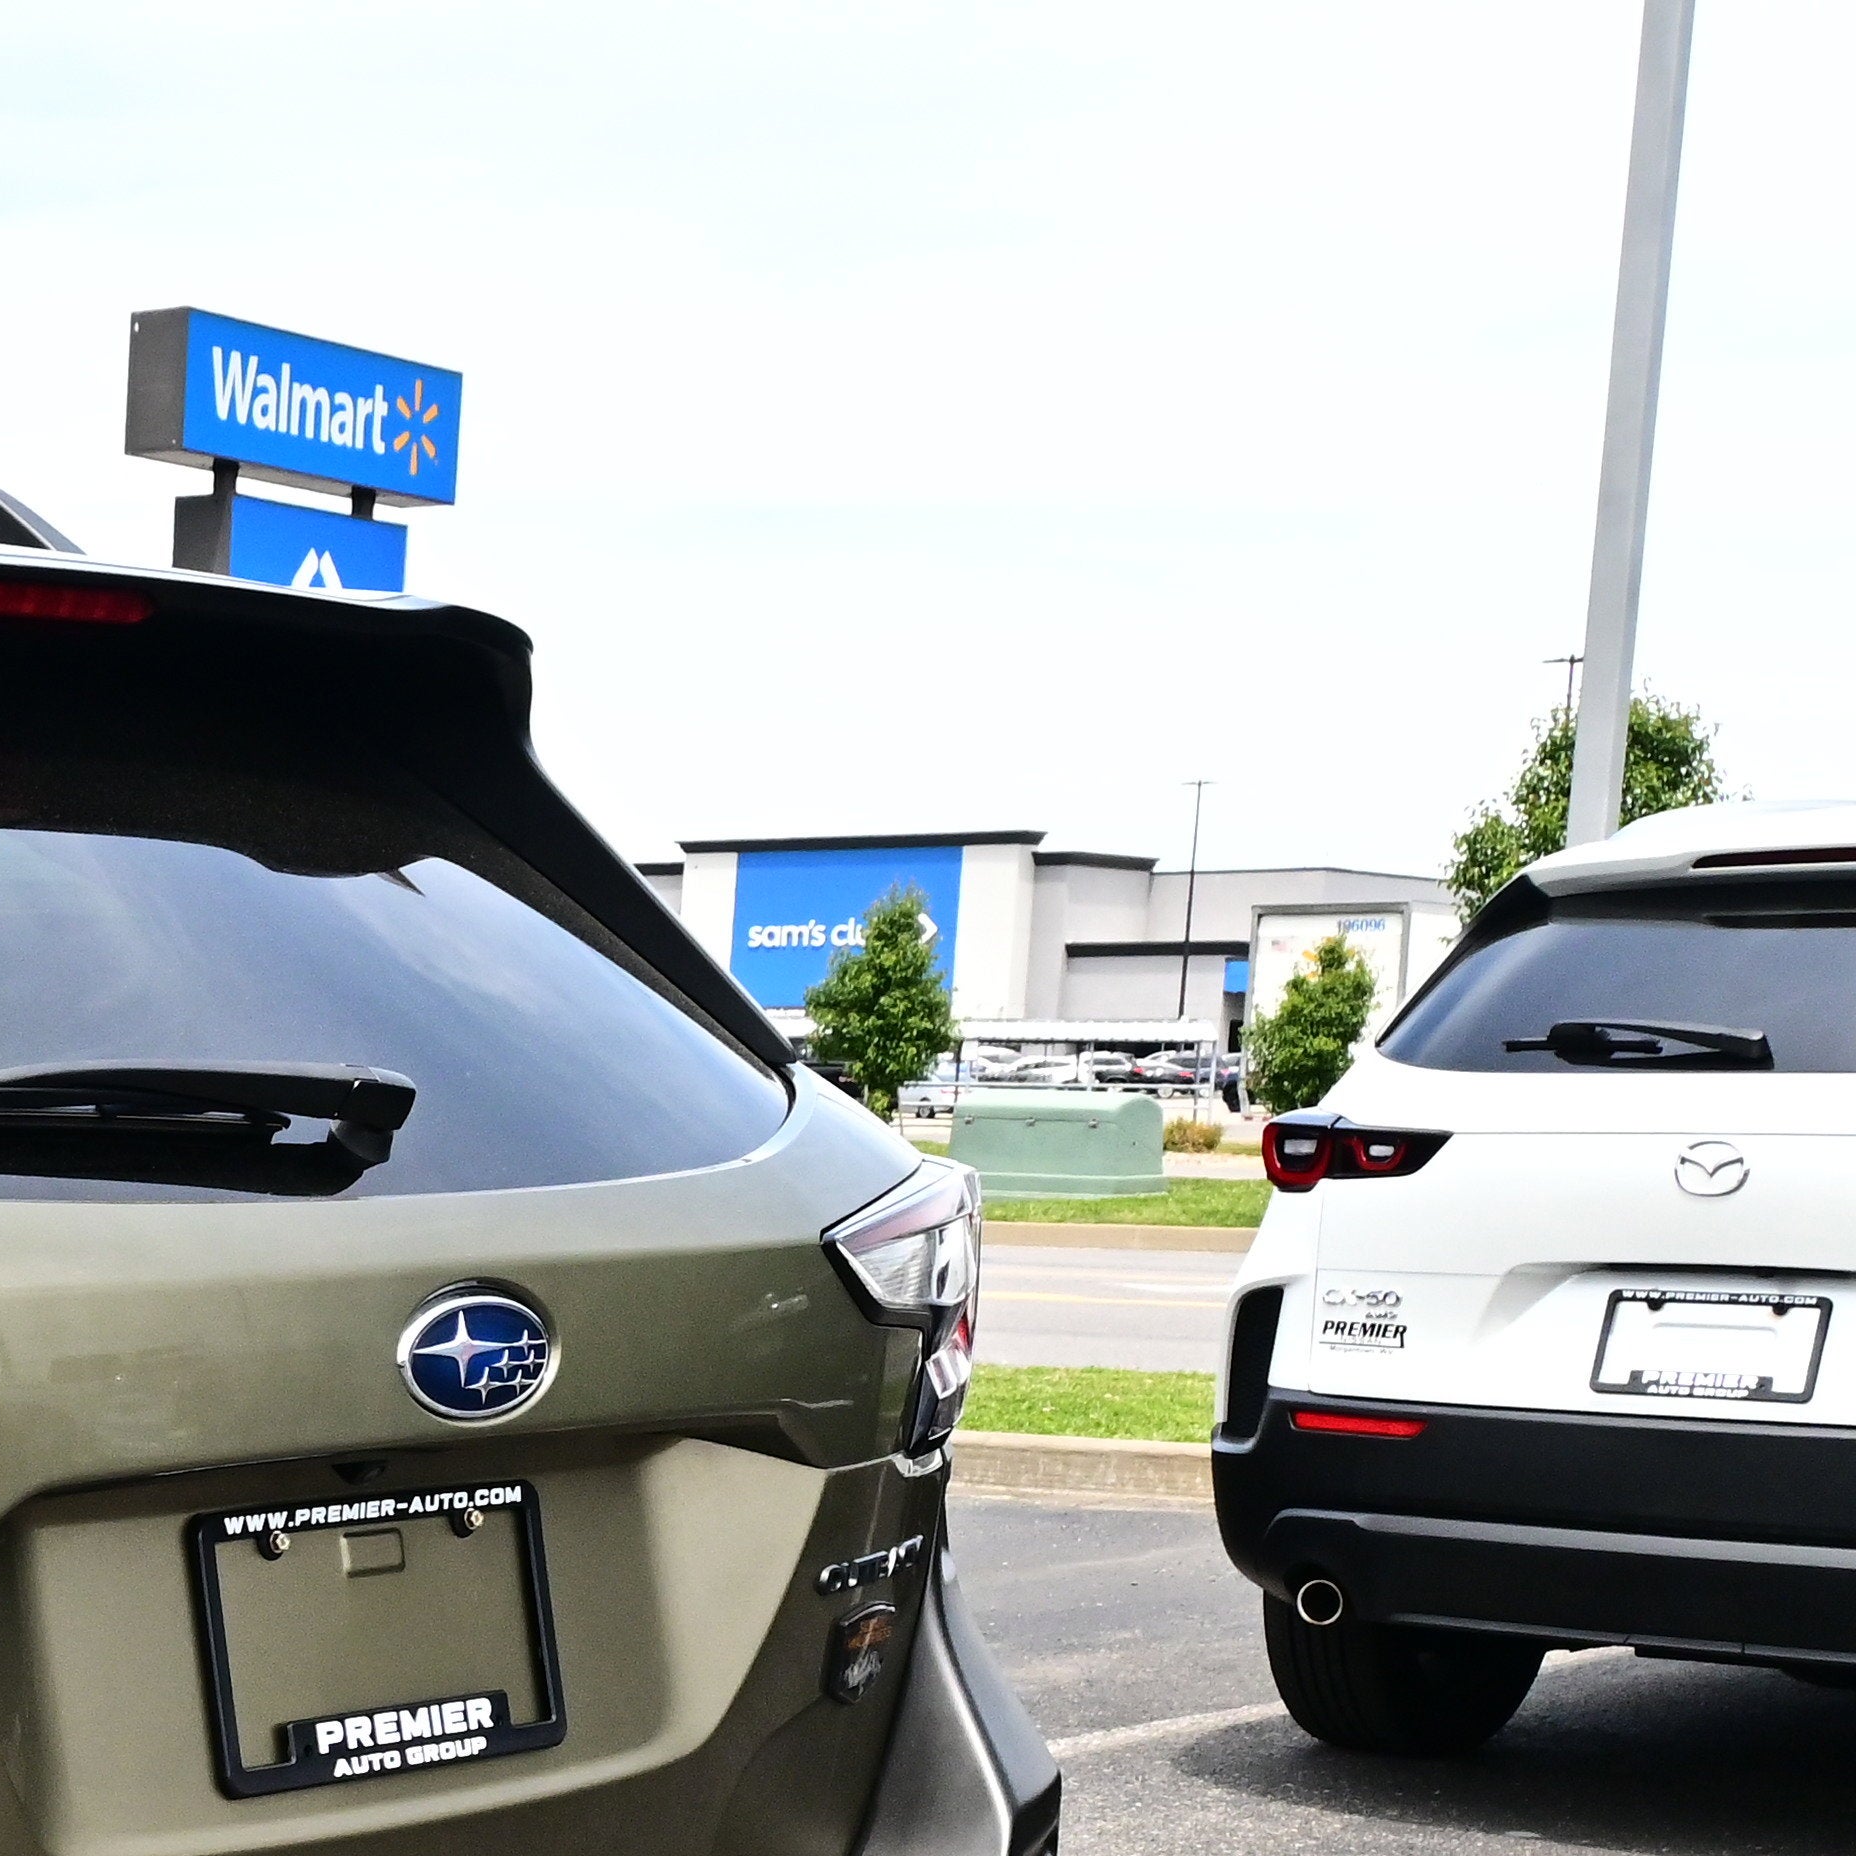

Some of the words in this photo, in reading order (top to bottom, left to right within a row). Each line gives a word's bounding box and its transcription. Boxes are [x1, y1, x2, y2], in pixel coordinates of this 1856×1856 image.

[212, 345, 389, 455] Walmart
[747, 918, 827, 948] sam's
[830, 916, 868, 947] clu
[1621, 1288, 1818, 1306] WWW.PREMIER-AUTO.COM
[1322, 1319, 1408, 1347] PREMIER
[1641, 1369, 1760, 1390] PREMIER
[1646, 1384, 1690, 1395] AUTO
[1692, 1385, 1750, 1398] GROUP
[224, 1485, 523, 1535] WWW.PREMIER-AUTO.COM
[315, 1696, 495, 1755] PREMIER
[333, 1748, 402, 1778] AUTO
[405, 1735, 488, 1766] GROUP
